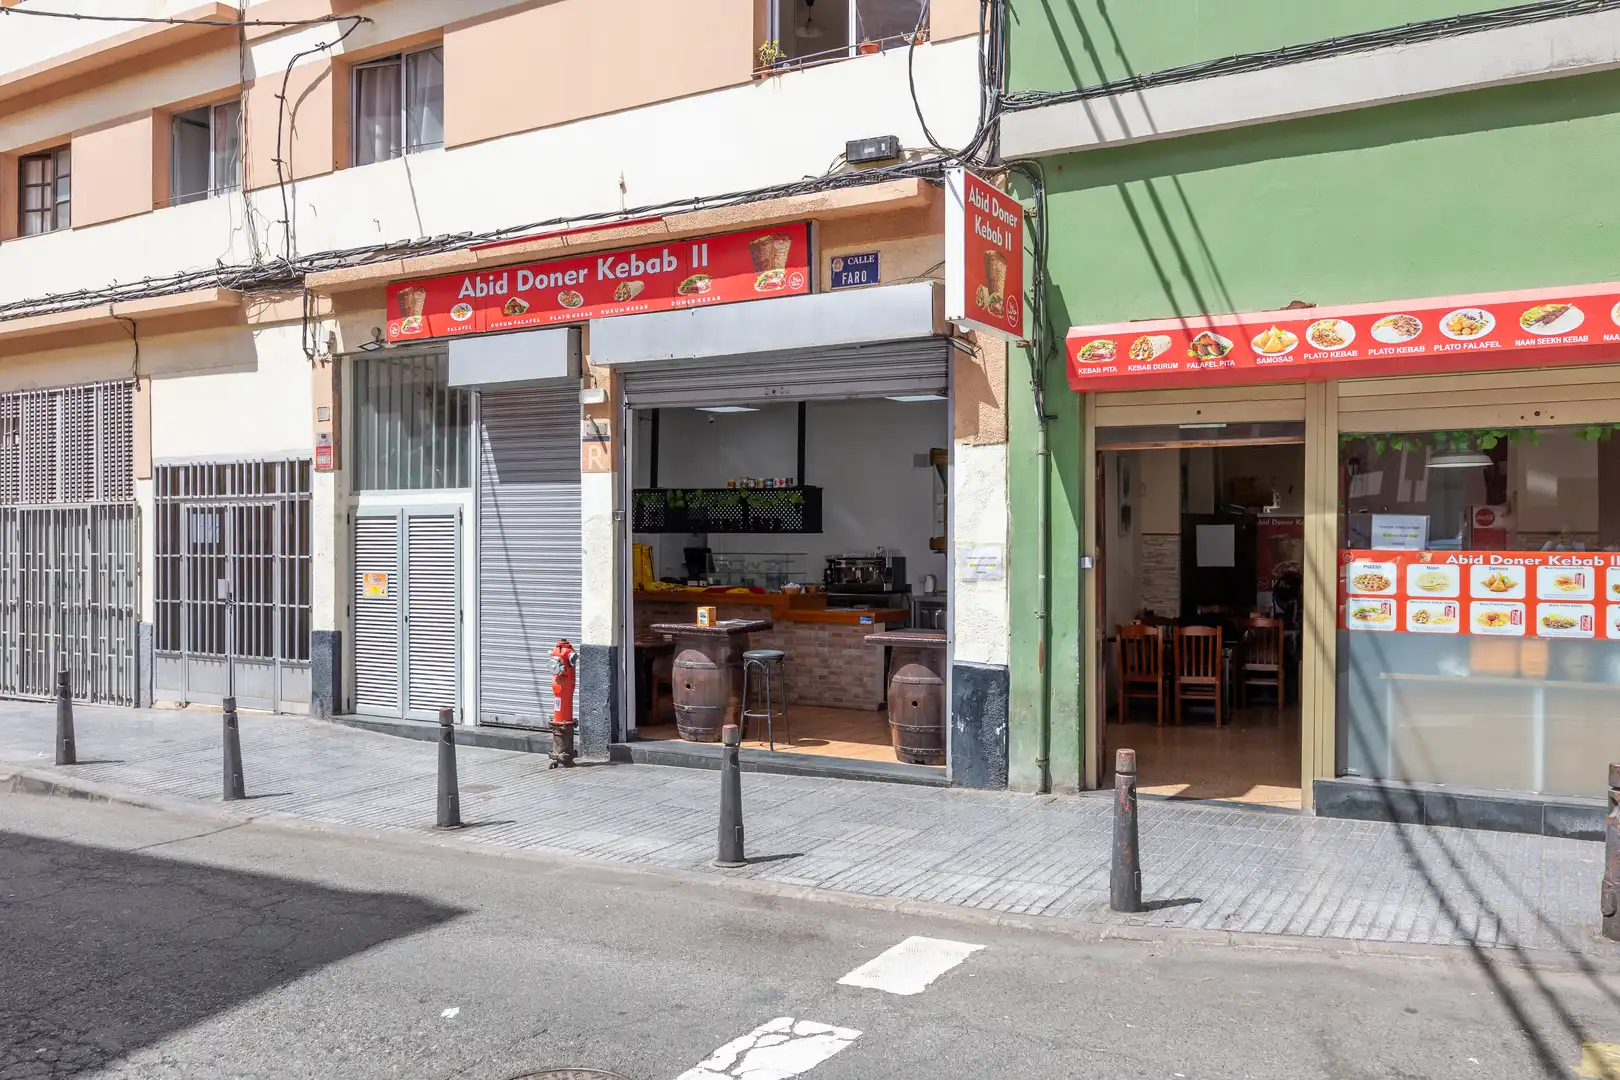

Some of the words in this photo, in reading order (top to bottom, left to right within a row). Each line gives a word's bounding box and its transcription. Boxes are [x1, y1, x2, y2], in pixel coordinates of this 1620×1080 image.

[968, 184, 990, 217] Abid
[992, 197, 1018, 229] Doner
[975, 215, 1003, 247] Kebab
[847, 255, 875, 265] CALLE
[458, 272, 508, 299] Abid
[517, 267, 588, 292] Doner
[597, 248, 678, 281] Kebab
[692, 243, 708, 269] II
[842, 270, 867, 285] FARO
[1433, 343, 1461, 351] PLATO
[1463, 340, 1502, 349] FALAFEL
[1515, 339, 1536, 347] NAAN
[1537, 337, 1561, 345] SEEKH
[1562, 335, 1589, 343] KEBAB
[1303, 351, 1328, 360] PLATO
[1330, 349, 1358, 358] KEBAB
[1368, 347, 1394, 356] PLATO
[1396, 344, 1425, 354] KEBAB
[1186, 361, 1218, 369] FALAFEL
[1219, 359, 1236, 367] PITA
[1256, 355, 1294, 365] SAMOSAS
[1078, 367, 1101, 375] KEBAB
[1102, 365, 1118, 373] PITA
[1153, 362, 1179, 371] DURUM
[588, 445, 604, 469] R
[1446, 554, 1483, 566] Abid
[1490, 554, 1543, 566] Doner
[1548, 555, 1605, 567] Kebab
